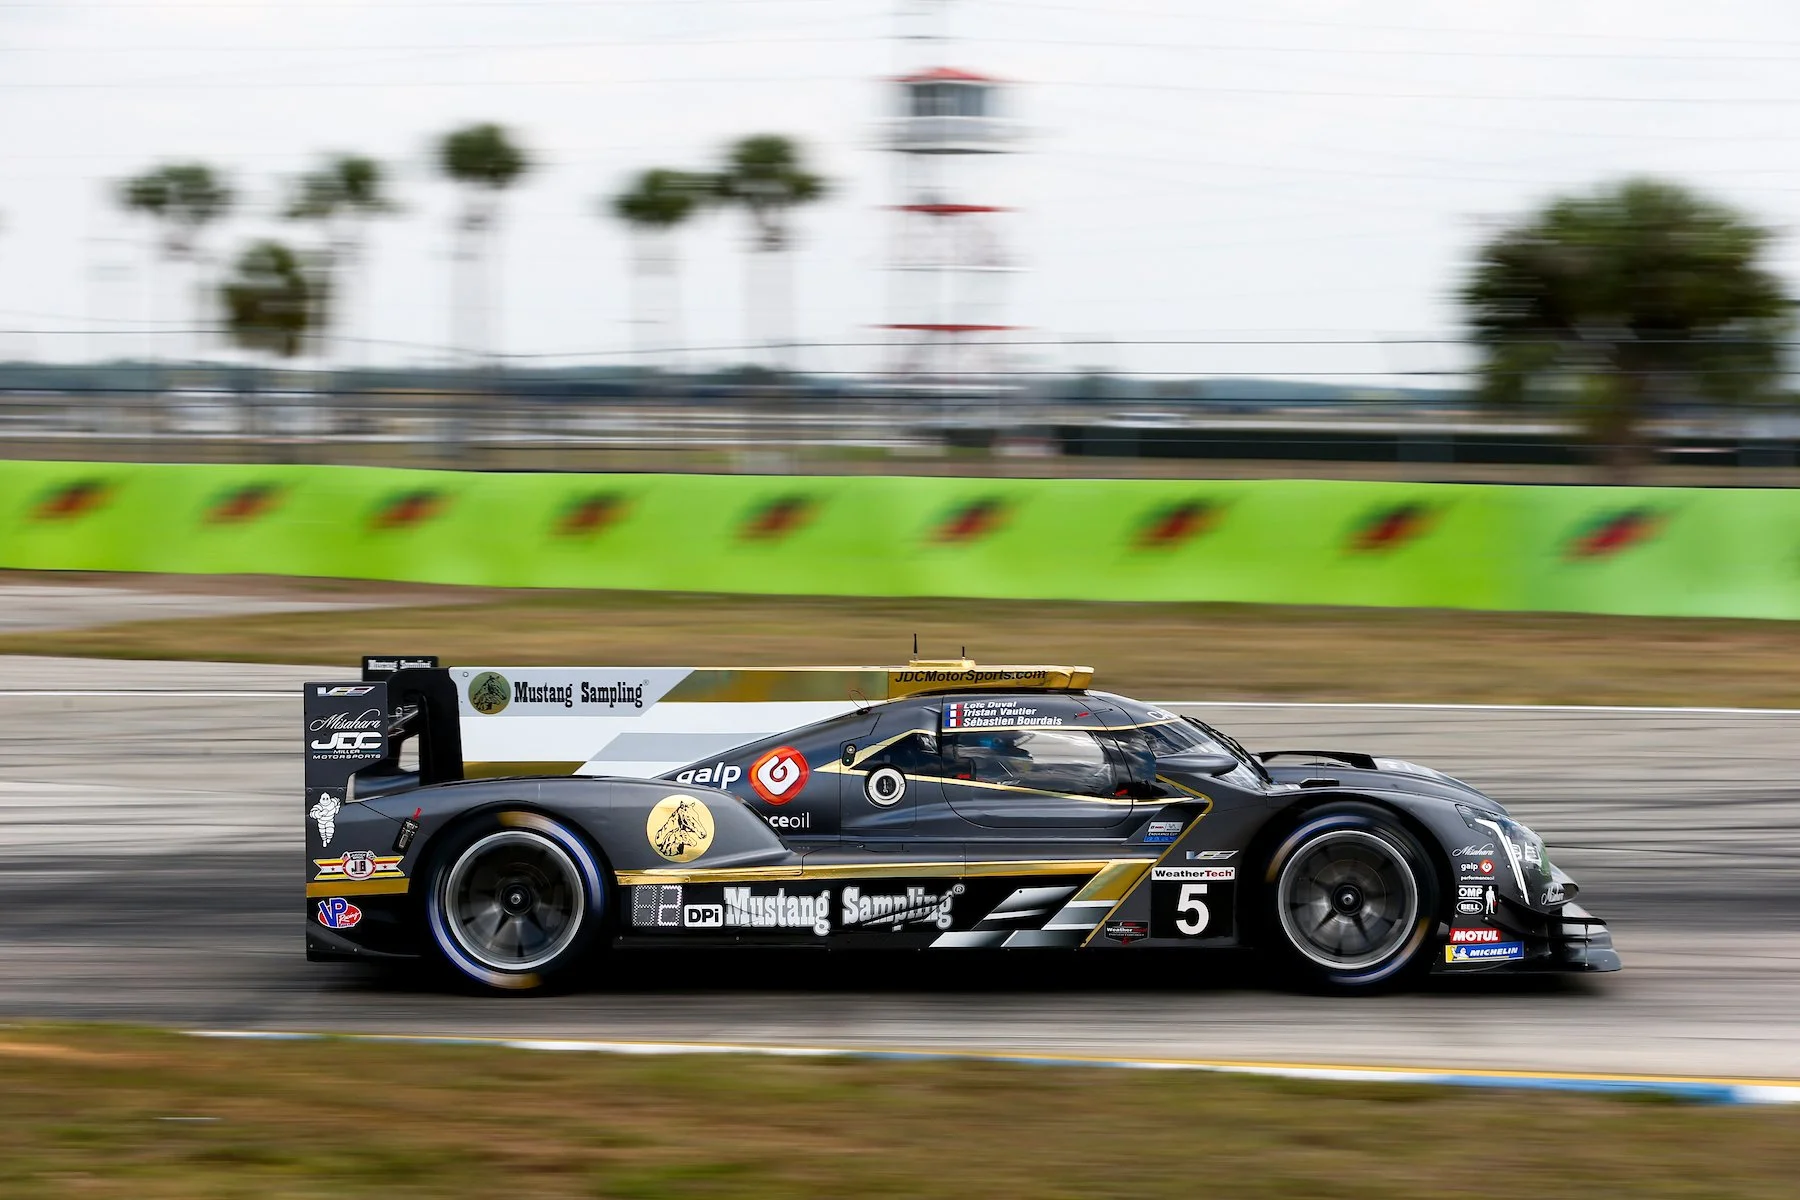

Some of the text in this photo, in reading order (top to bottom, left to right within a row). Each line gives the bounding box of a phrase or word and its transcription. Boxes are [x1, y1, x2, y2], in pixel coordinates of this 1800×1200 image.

[895, 670, 1048, 683] JDCMotorSports.com
[514, 681, 573, 708] Mustang
[963, 708, 1037, 717] Tristan Vautier
[310, 709, 381, 731] Misahara
[963, 716, 1063, 727] Sébastien Bourdais
[311, 732, 382, 749] JDC
[1155, 869, 1233, 878] WeatherTech
[1461, 862, 1479, 872] galp
[1458, 887, 1482, 897] OMP
[318, 897, 347, 928] VP
[688, 908, 719, 922] DPi
[723, 887, 831, 936] Mustang
[1176, 883, 1209, 935] 5
[1453, 930, 1499, 941] MOTUL
[1469, 946, 1519, 957] MICHELIN
